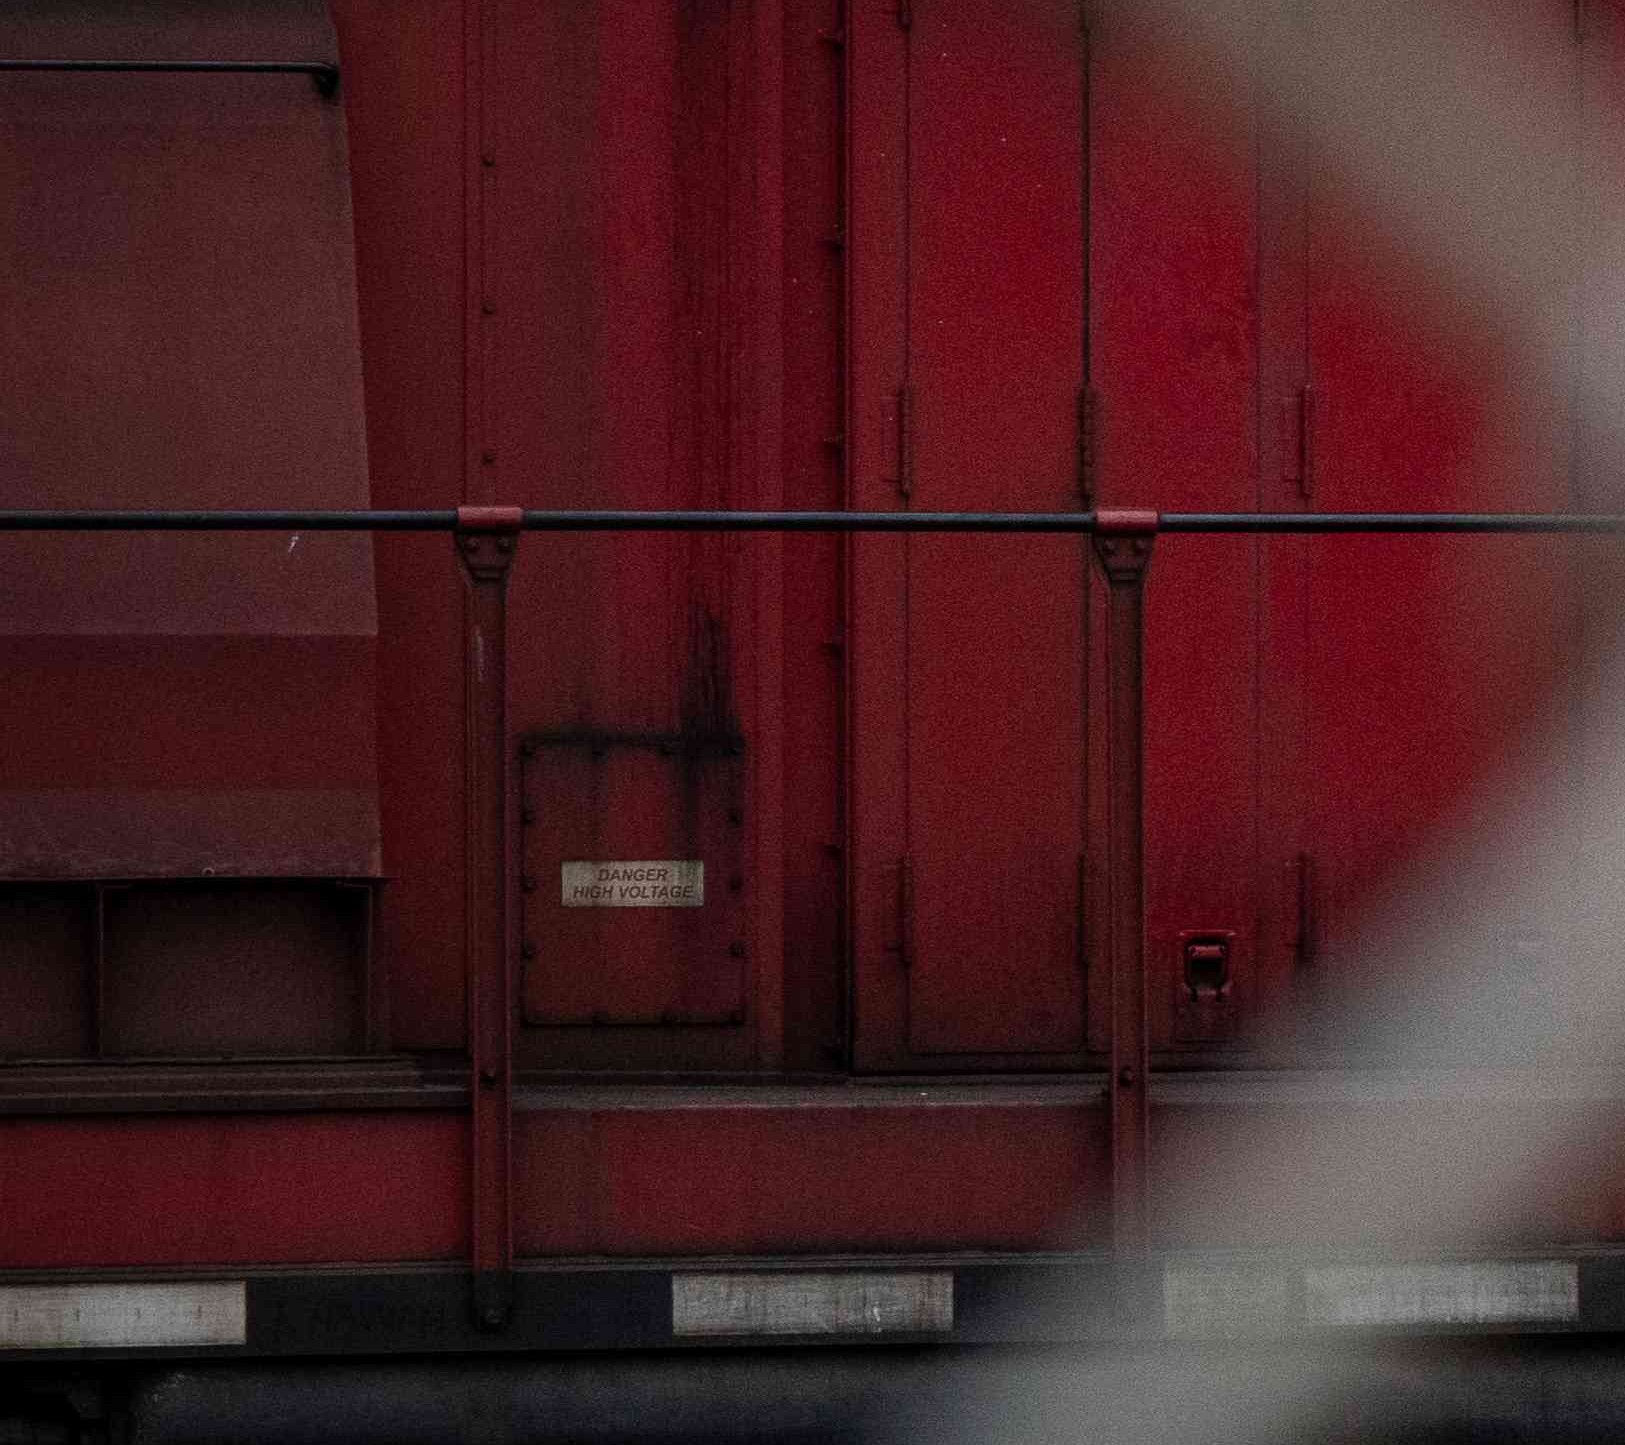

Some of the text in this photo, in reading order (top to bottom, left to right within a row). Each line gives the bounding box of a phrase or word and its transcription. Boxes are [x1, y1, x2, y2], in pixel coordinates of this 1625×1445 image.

[597, 868, 669, 882] DANGER
[573, 884, 696, 899] HIGH VOLTAGE
